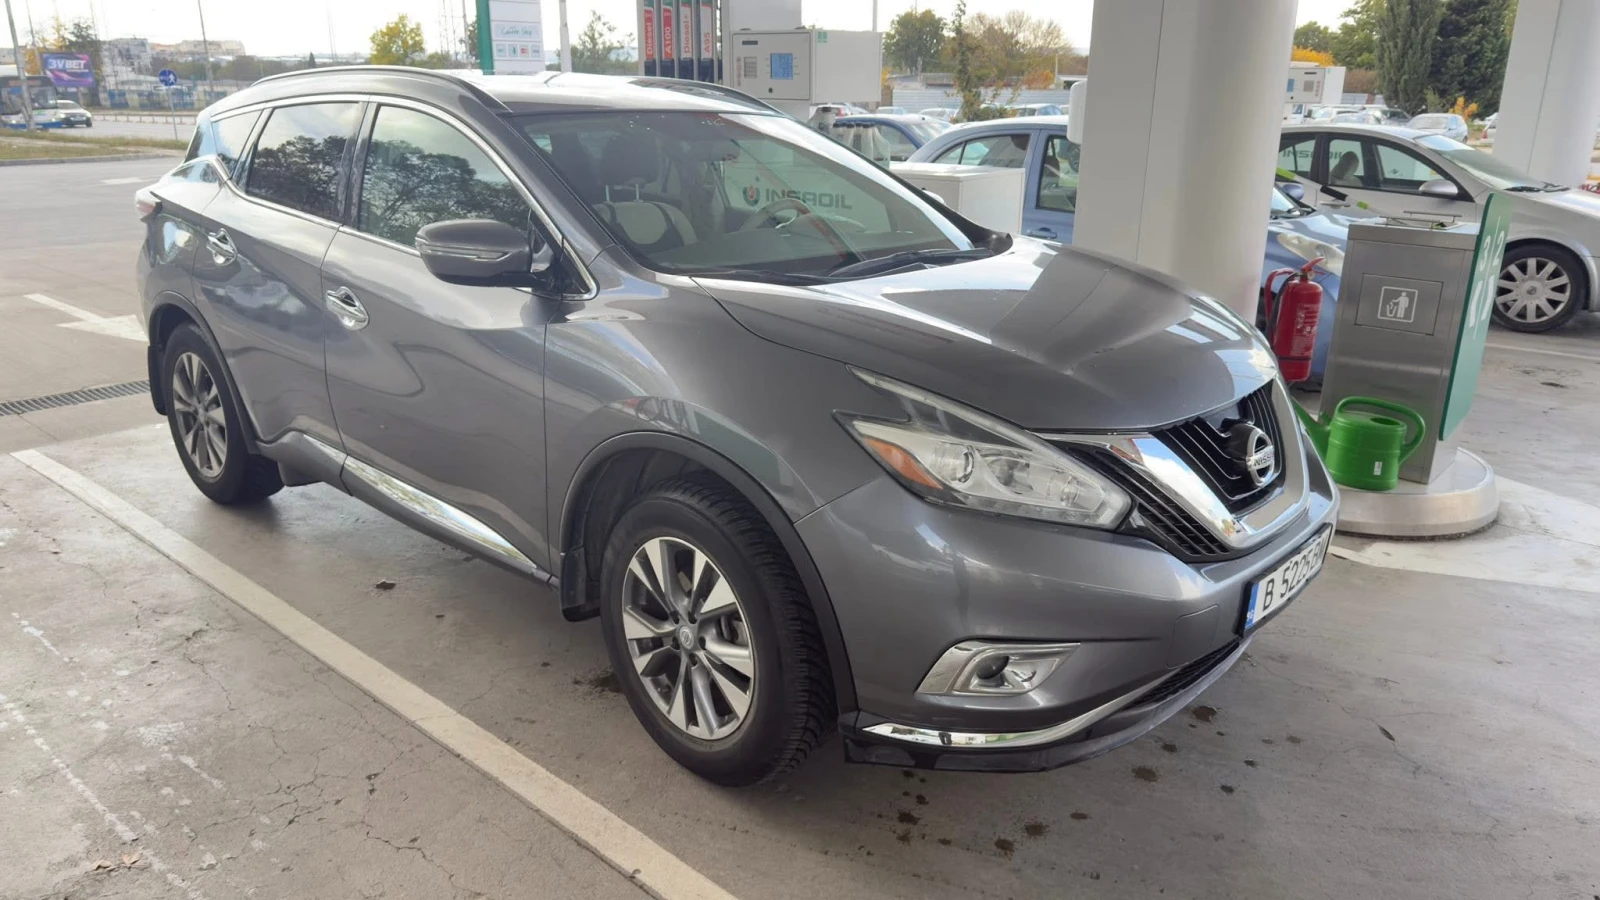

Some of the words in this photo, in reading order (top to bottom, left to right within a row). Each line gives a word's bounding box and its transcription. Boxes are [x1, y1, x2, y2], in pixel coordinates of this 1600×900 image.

[1480, 235, 1491, 271] 3
[1493, 231, 1505, 266] 2
[1263, 577, 1275, 611] B
